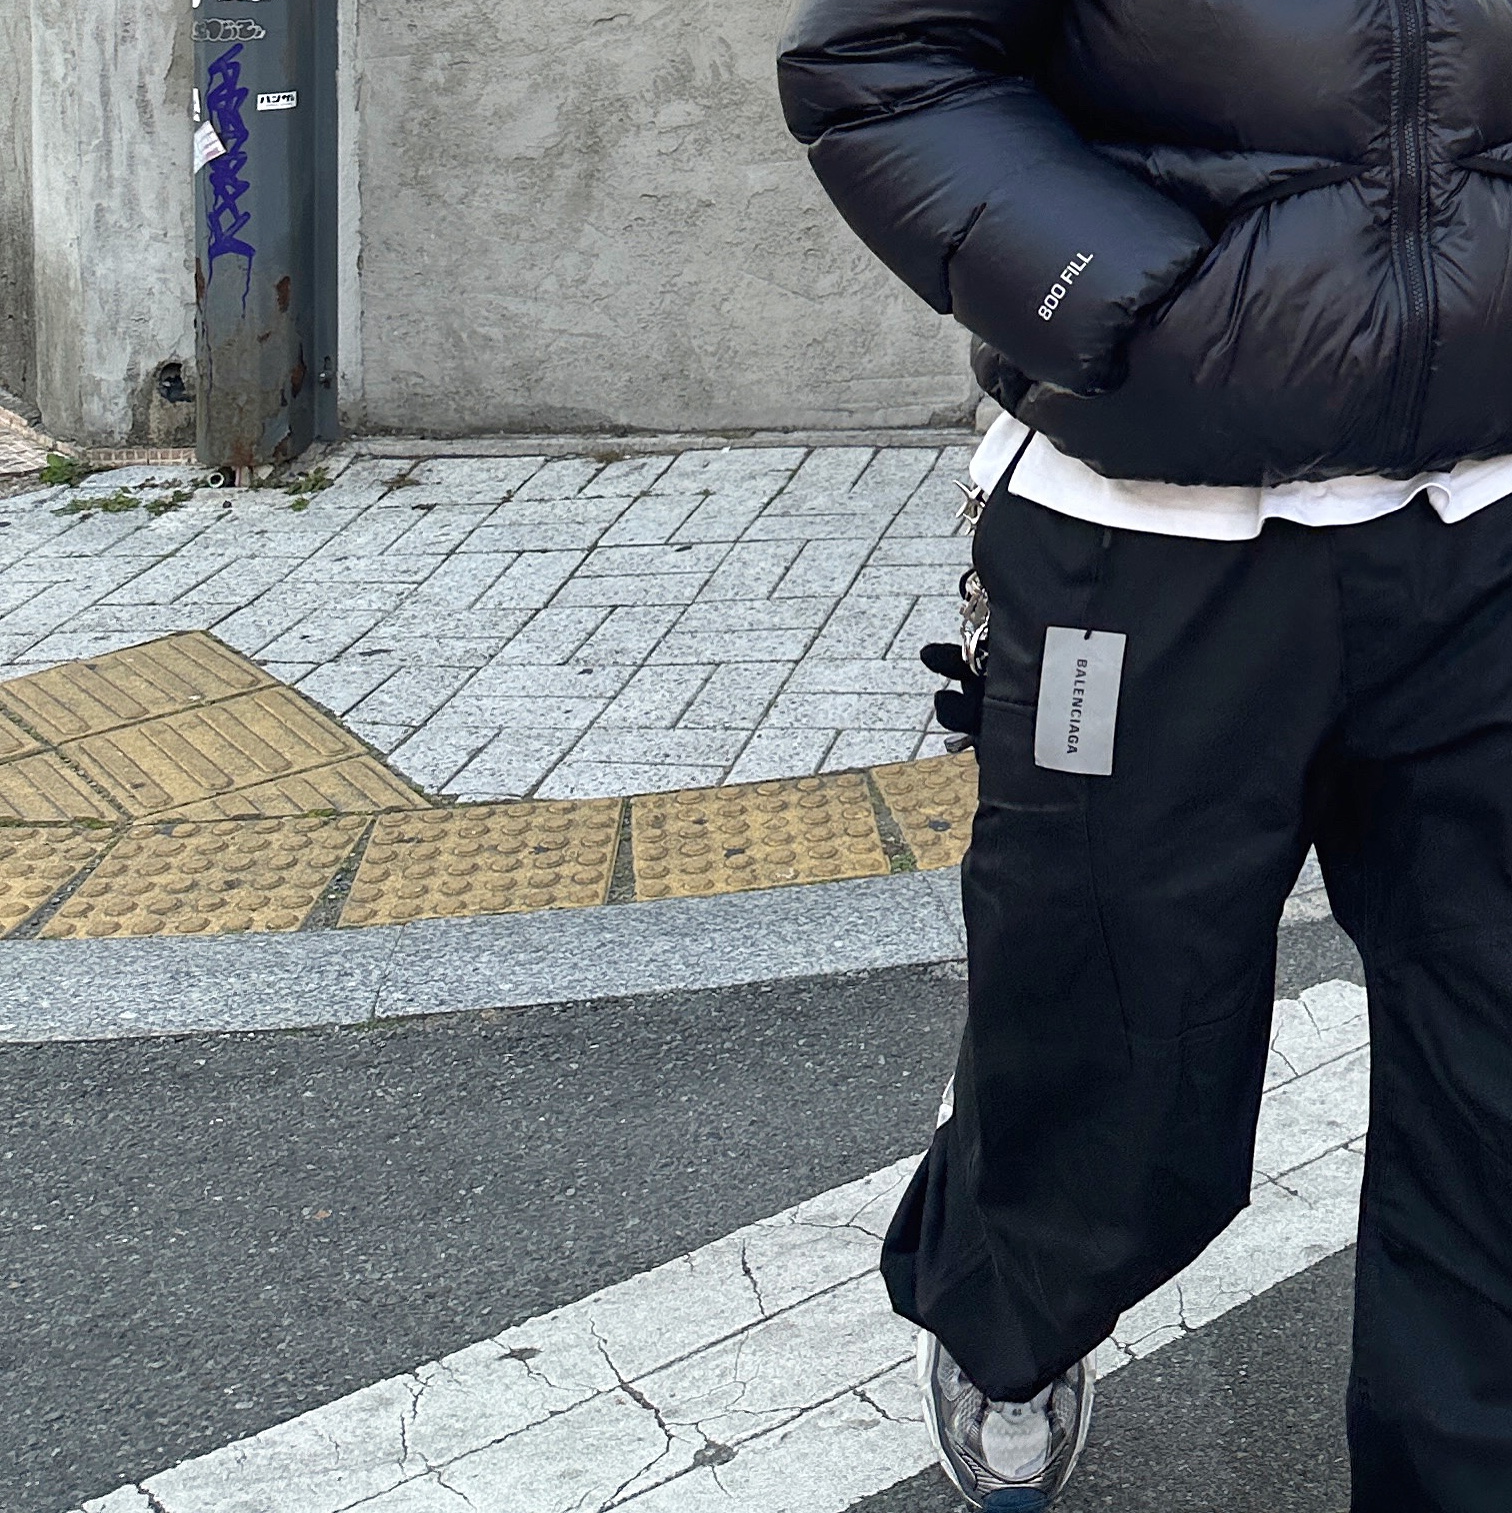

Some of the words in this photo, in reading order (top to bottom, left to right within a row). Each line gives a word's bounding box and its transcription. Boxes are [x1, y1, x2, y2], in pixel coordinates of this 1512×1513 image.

[1037, 283, 1066, 321] 800
[1060, 252, 1094, 285] FILL
[1065, 657, 1088, 755] BALENCIAGA
